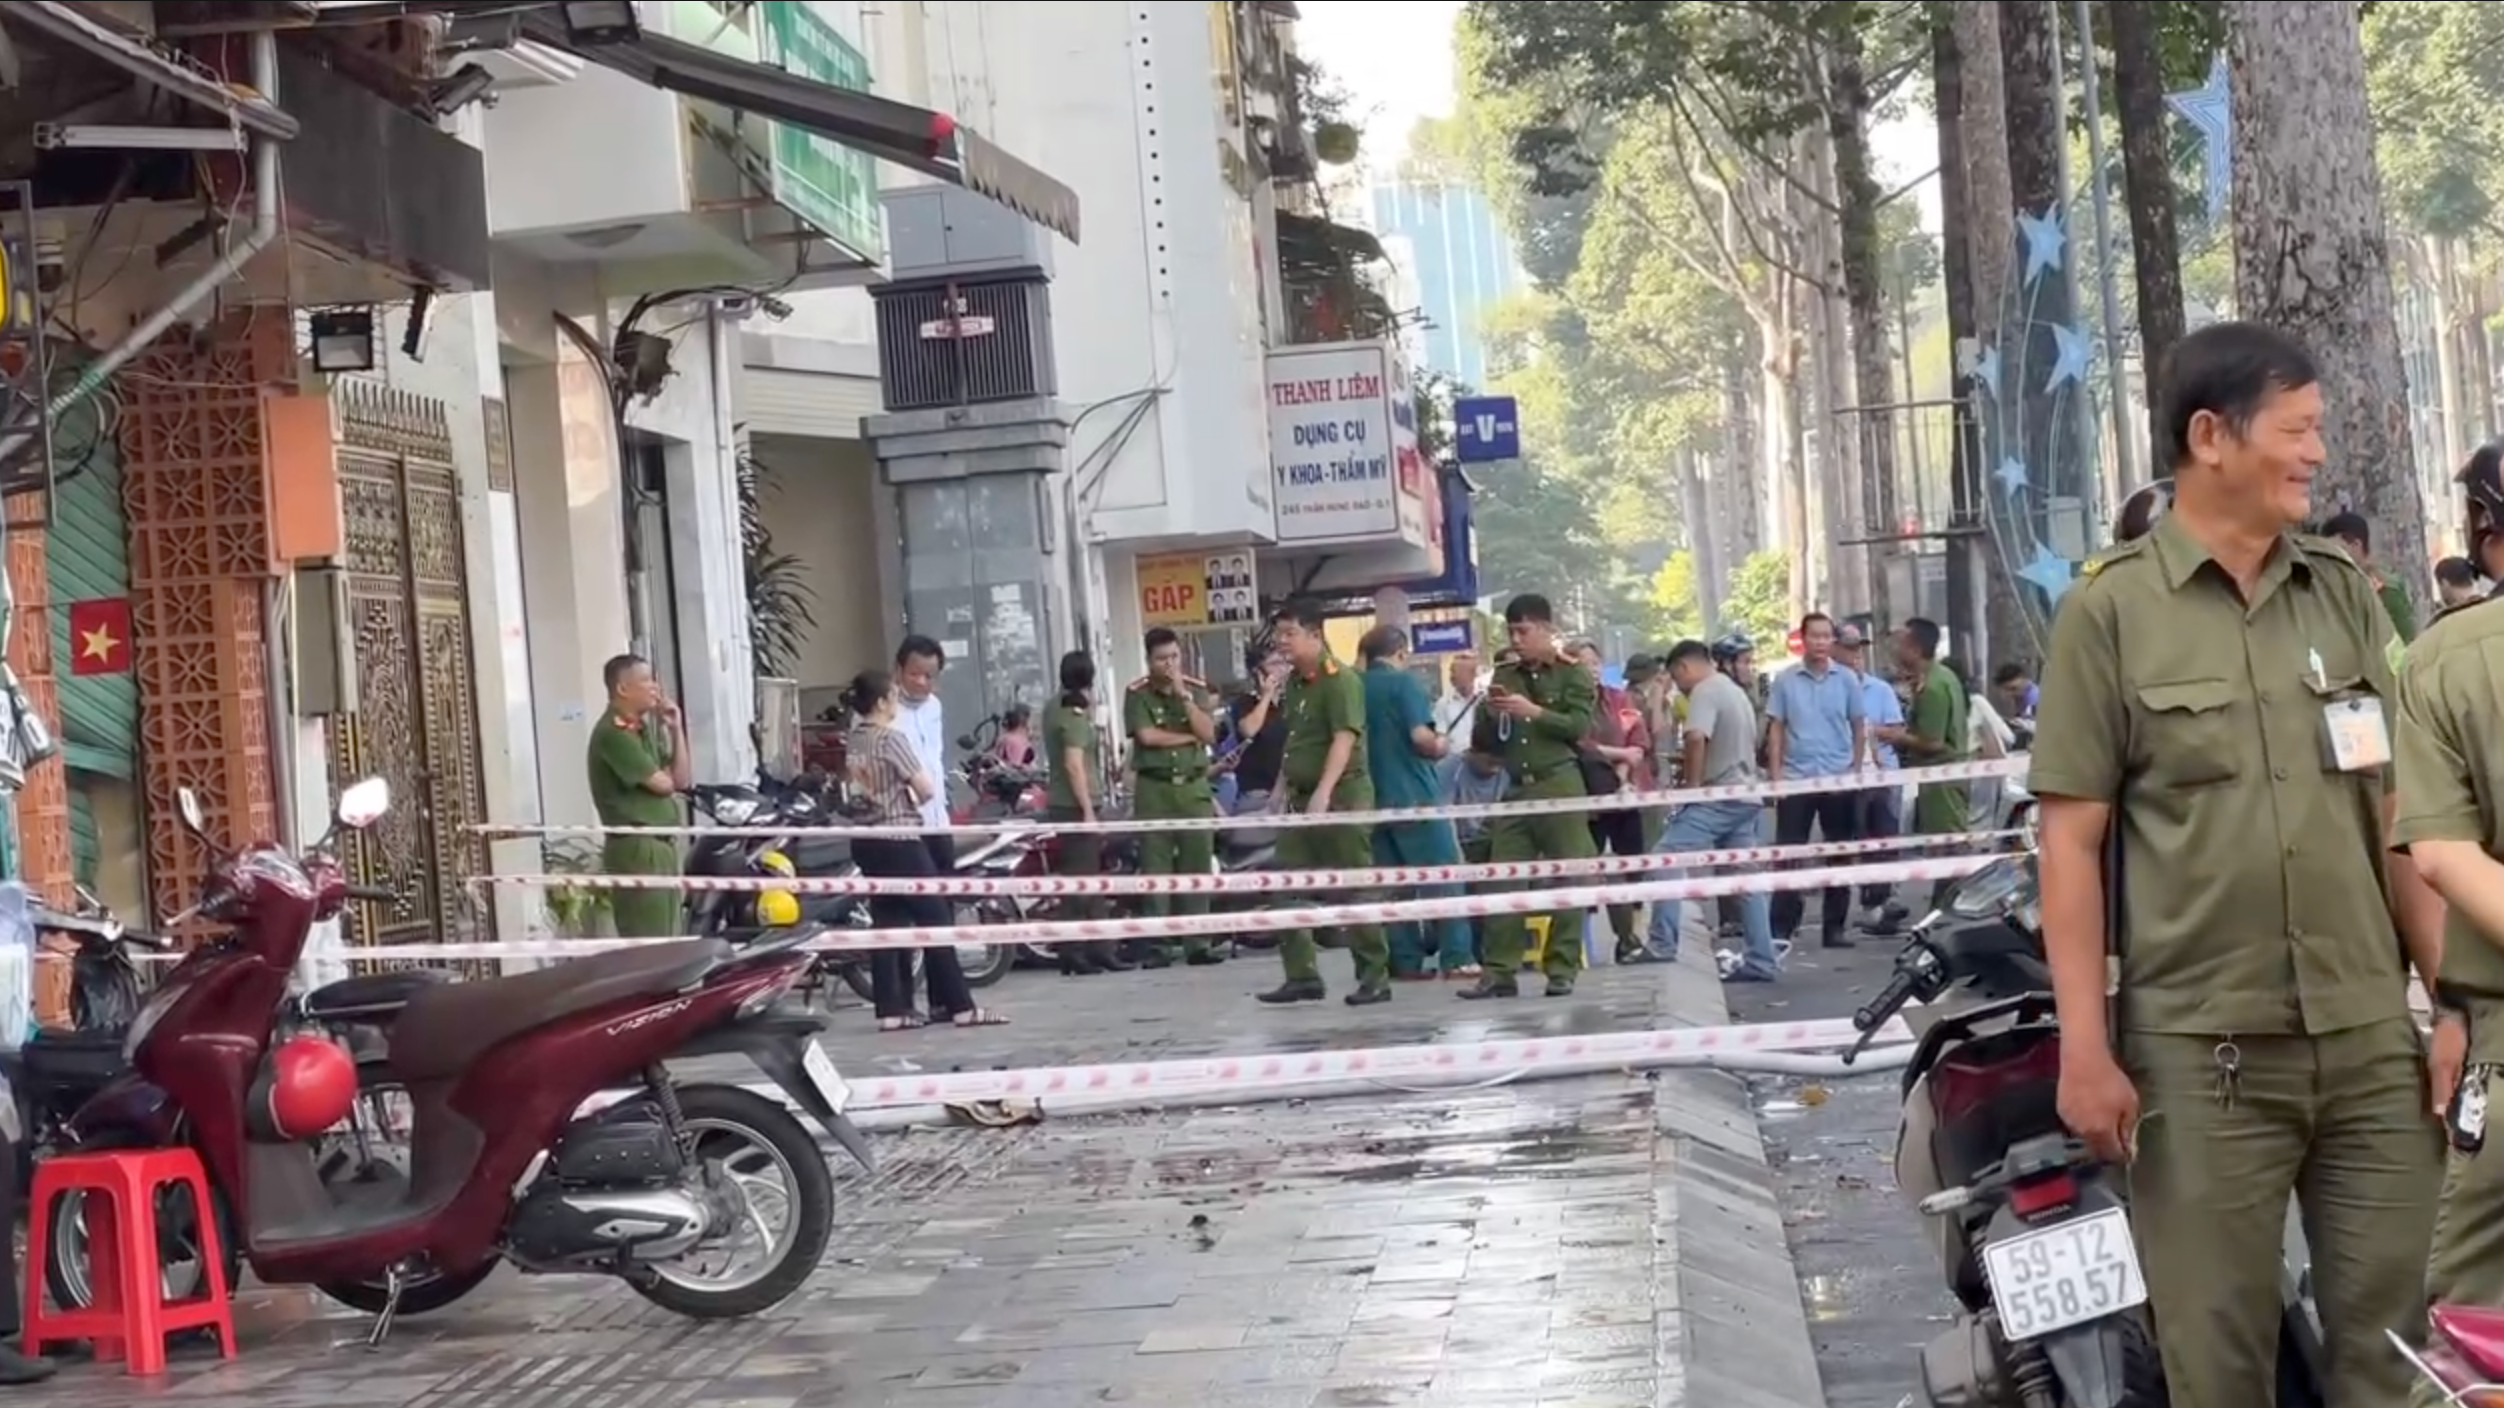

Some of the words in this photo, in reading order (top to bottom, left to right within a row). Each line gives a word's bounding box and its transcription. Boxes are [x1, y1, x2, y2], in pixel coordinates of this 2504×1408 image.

[1272, 379, 1331, 406] THANH
[1337, 372, 1380, 400] LIÊM
[1294, 422, 1338, 448] DỤNG
[1345, 419, 1366, 445] CỤ
[1475, 414, 1496, 442] V
[1277, 466, 1286, 487] Y
[606, 999, 691, 1035] VISION
[2027, 1204, 2071, 1221] HONDA
[2009, 1222, 2113, 1284] 59-T2
[2009, 1260, 2127, 1330] 558.57
